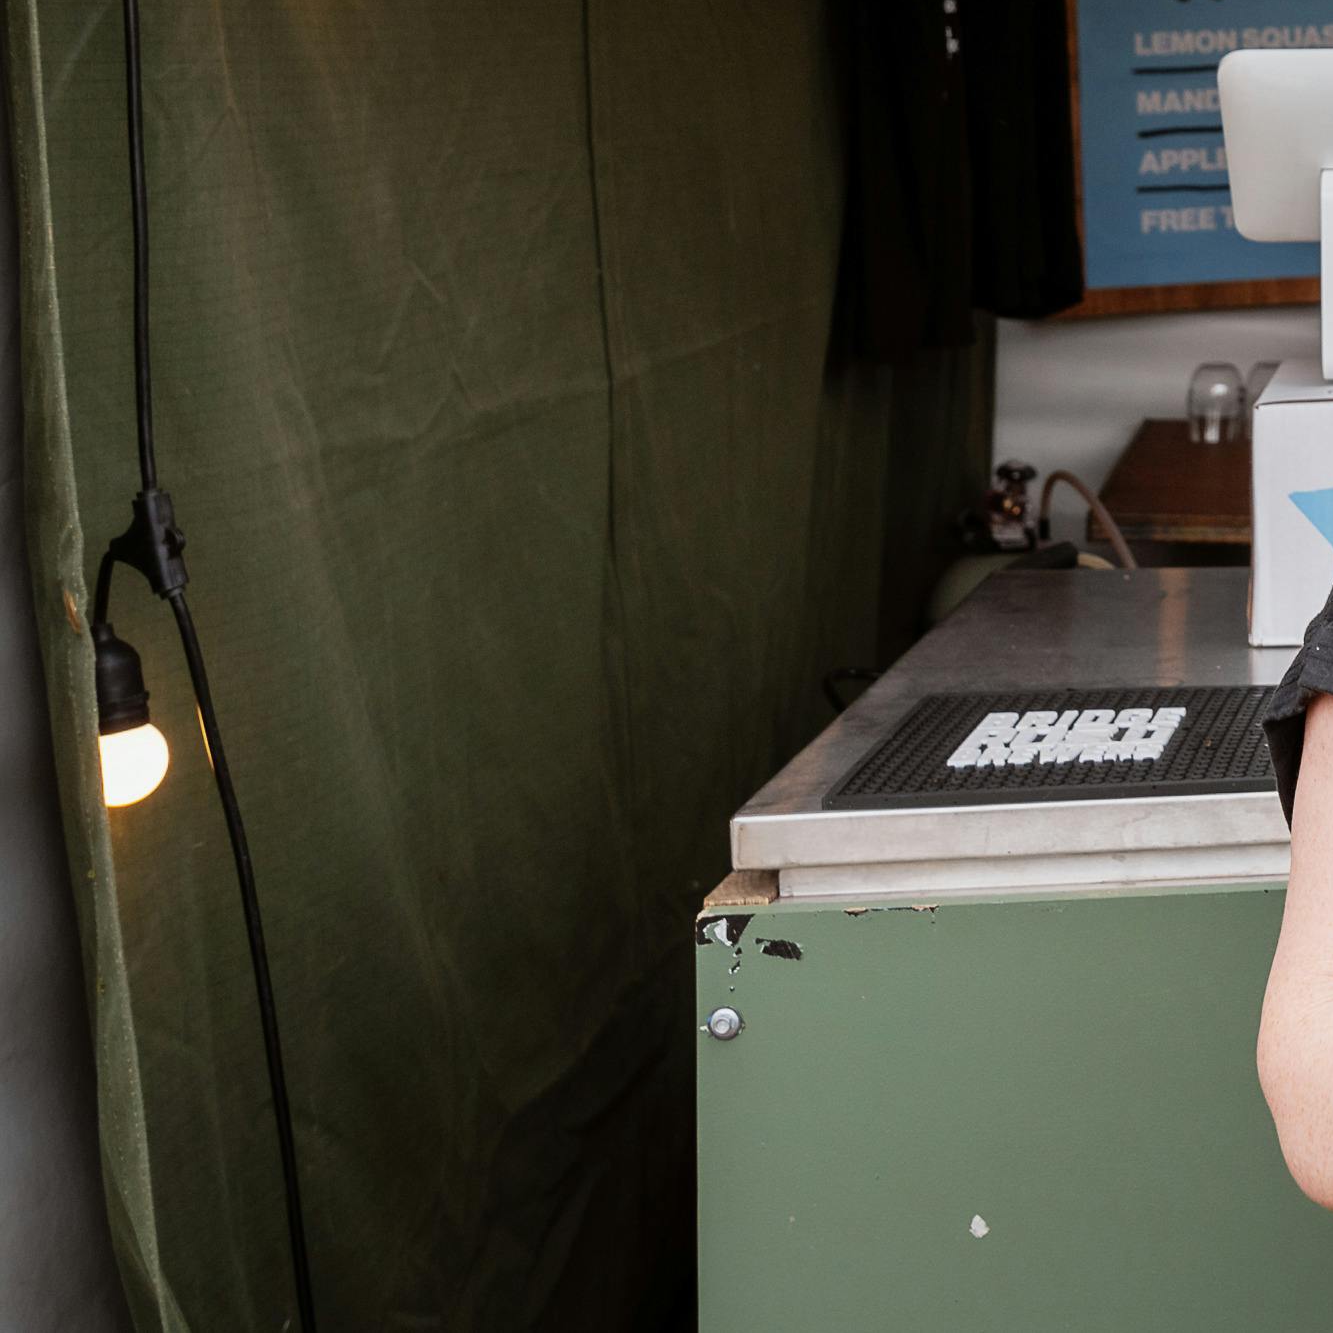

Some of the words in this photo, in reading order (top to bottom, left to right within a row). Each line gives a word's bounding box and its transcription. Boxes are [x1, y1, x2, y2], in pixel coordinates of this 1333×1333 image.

[1134, 30, 1237, 56] LEMON
[1141, 207, 1215, 233] FREE
[980, 707, 1187, 729] BRIDGE
